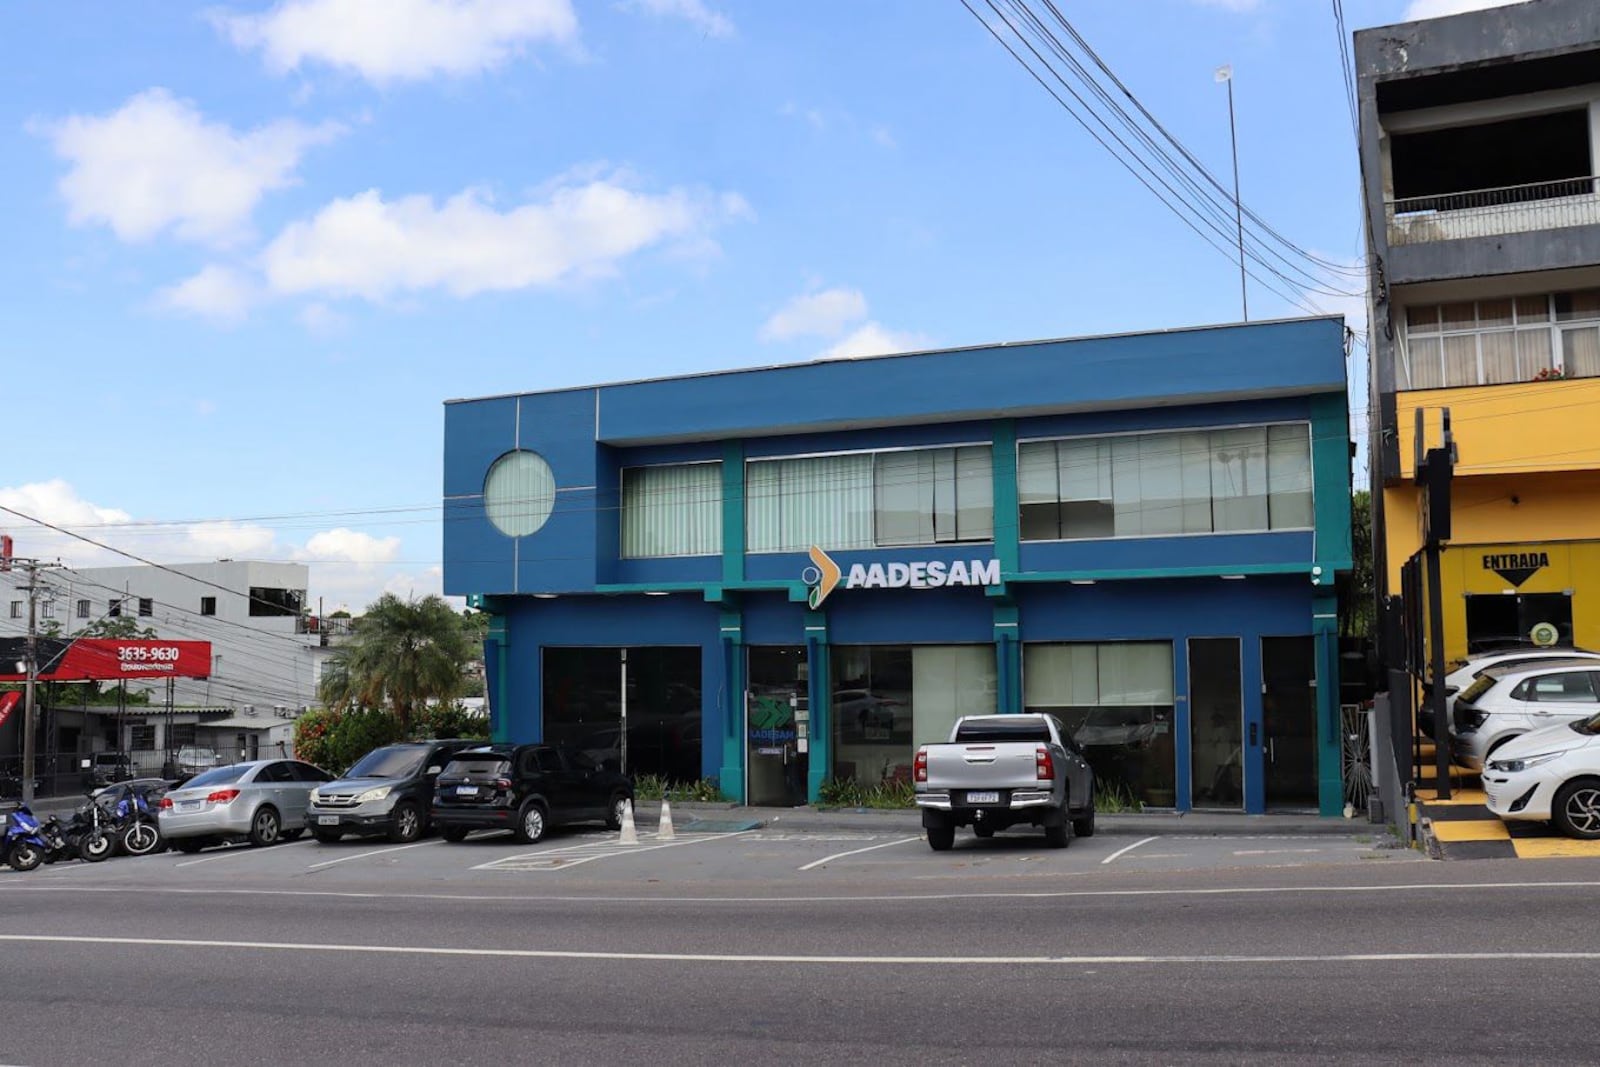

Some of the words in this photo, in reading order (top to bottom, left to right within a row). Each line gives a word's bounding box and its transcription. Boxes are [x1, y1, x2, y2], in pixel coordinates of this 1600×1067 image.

[1483, 552, 1549, 569] ENTRADA
[846, 559, 1001, 588] AADESAM
[118, 647, 179, 660] 3635-9630
